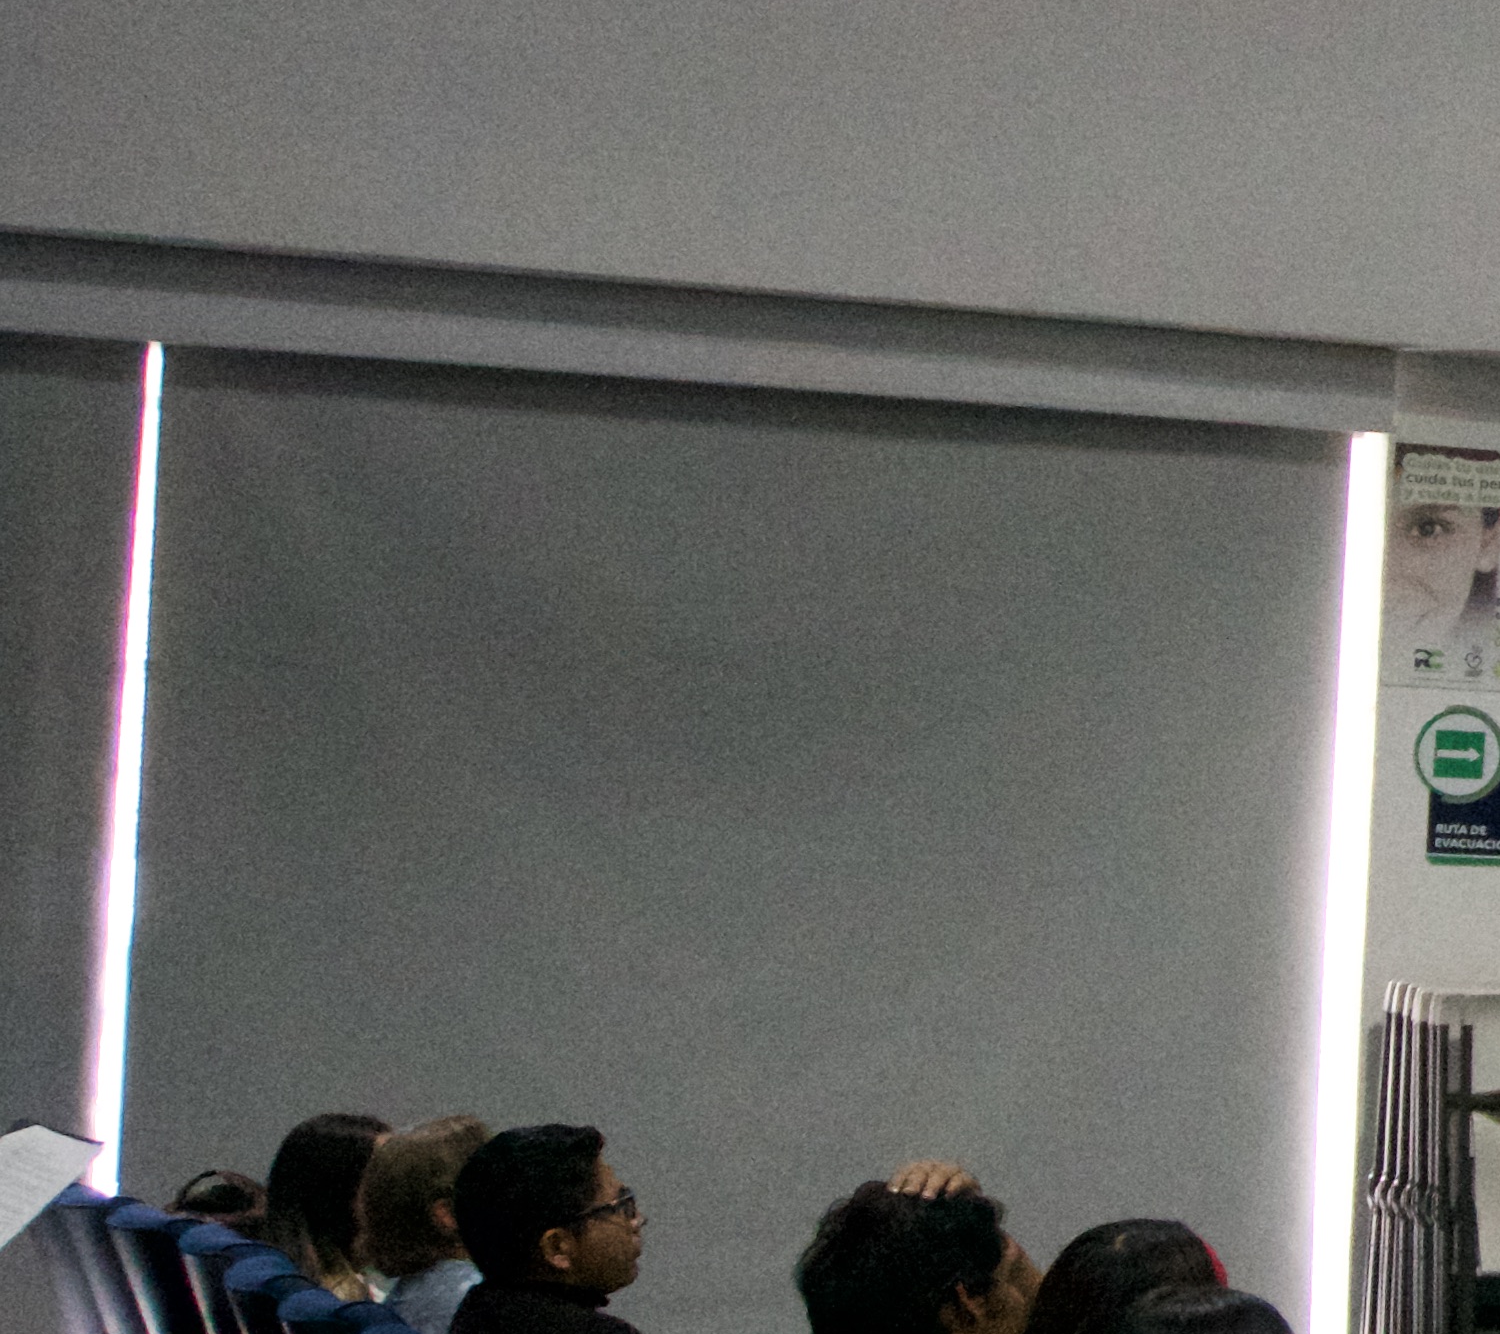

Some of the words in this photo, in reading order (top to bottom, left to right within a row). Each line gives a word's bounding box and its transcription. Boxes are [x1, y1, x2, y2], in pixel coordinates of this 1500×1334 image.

[1406, 471, 1447, 485] cuida
[1452, 473, 1474, 488] tus
[1435, 823, 1469, 835] RUTA
[1470, 824, 1488, 836] DE
